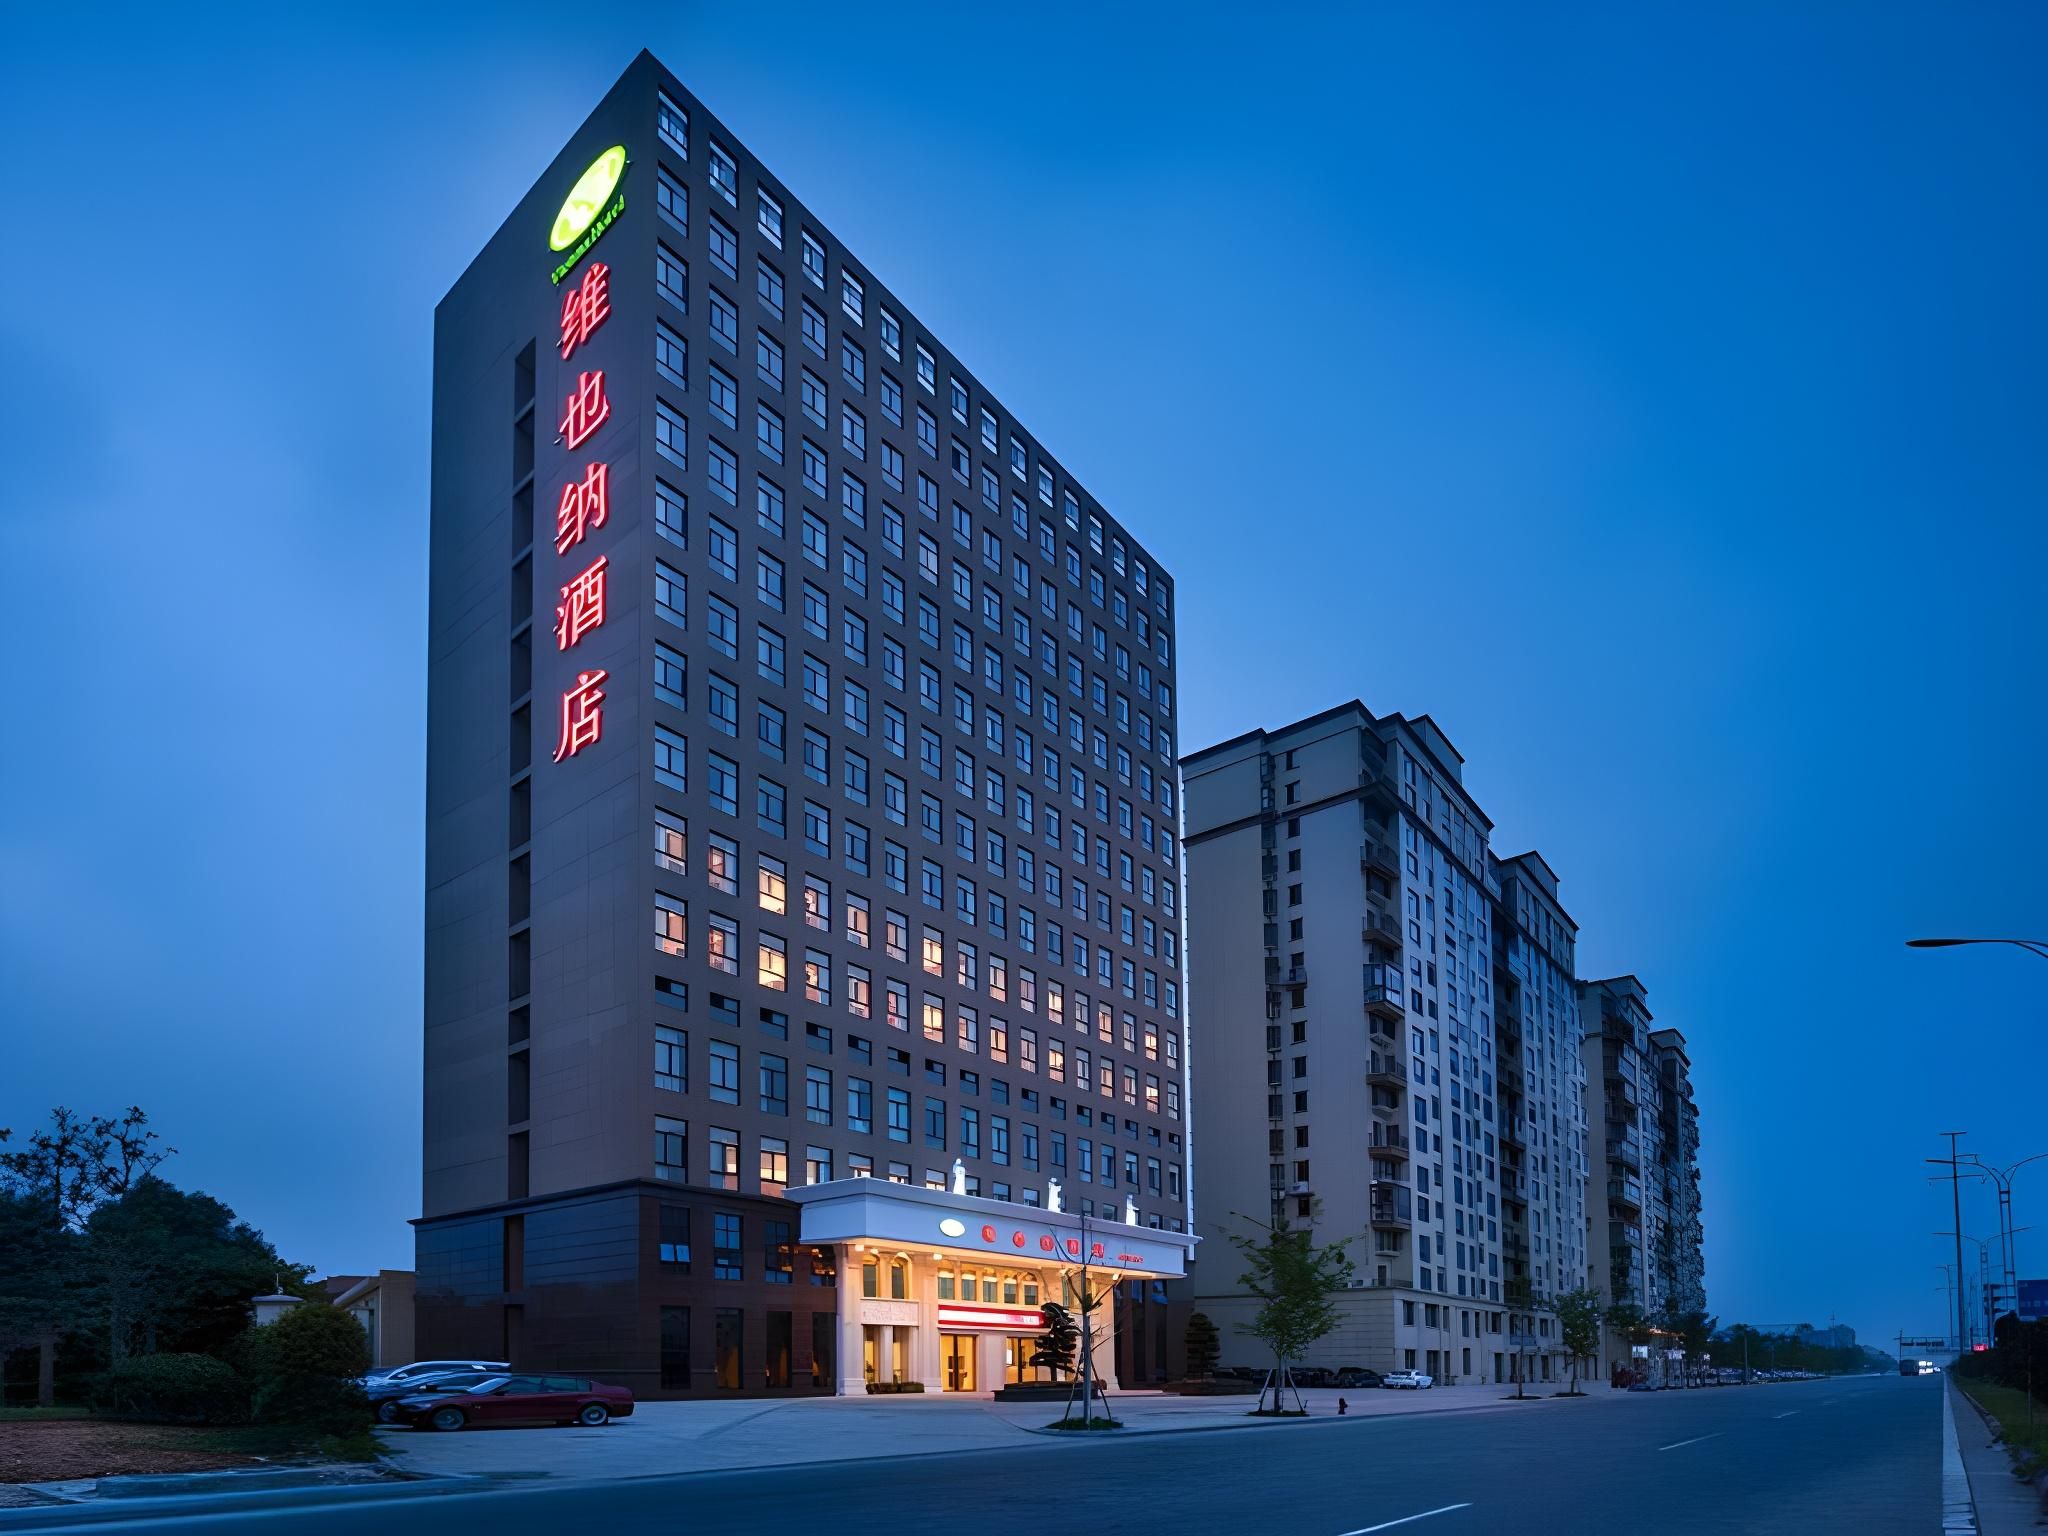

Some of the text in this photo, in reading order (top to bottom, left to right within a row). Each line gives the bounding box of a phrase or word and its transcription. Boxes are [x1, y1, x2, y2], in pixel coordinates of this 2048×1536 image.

[554, 263, 611, 762] 维也纳酒店
